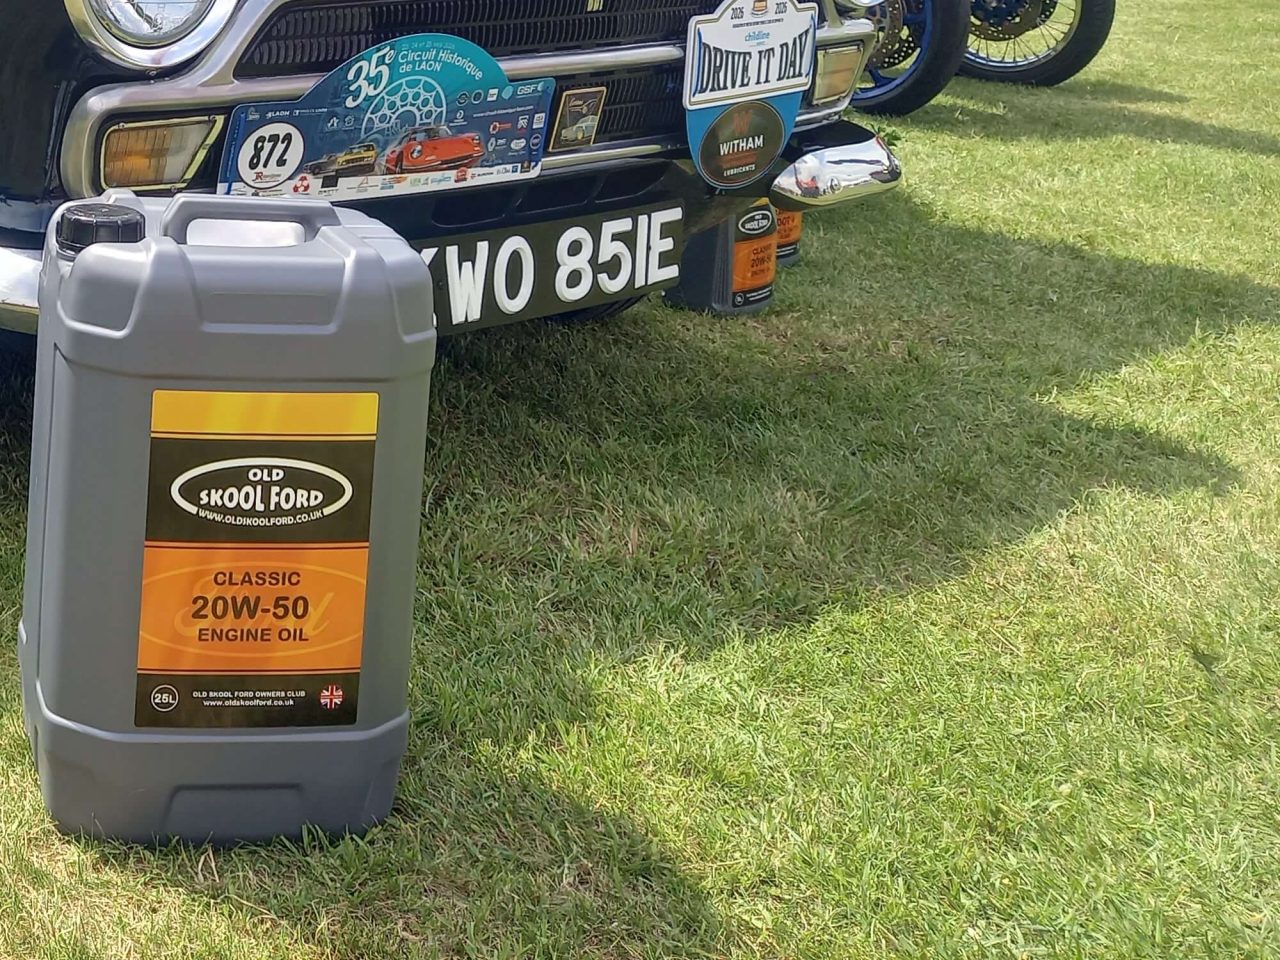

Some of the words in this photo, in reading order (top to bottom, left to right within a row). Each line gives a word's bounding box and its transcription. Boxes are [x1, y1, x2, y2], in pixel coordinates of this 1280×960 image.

[399, 49, 437, 63] Circuit
[438, 50, 484, 81] Historique
[399, 62, 413, 73] de
[415, 61, 443, 73] LAON
[697, 41, 752, 94] DRIVE
[754, 47, 776, 86] IT
[776, 27, 811, 81] DAY
[248, 131, 293, 171] 872
[719, 134, 764, 156] WITHAM
[554, 206, 683, 304] 851E
[247, 467, 286, 483] OLD
[199, 484, 266, 512] SKOOL
[269, 485, 324, 511] FORD
[198, 507, 325, 527] WWW.OLDSKOOLFORD.CO.UK
[213, 570, 302, 587] CLASSIC
[191, 594, 310, 620] 20W-50
[197, 627, 272, 643] ENGINE
[277, 627, 310, 642] OIL
[154, 693, 176, 704] 25L
[287, 690, 306, 698] CLUB
